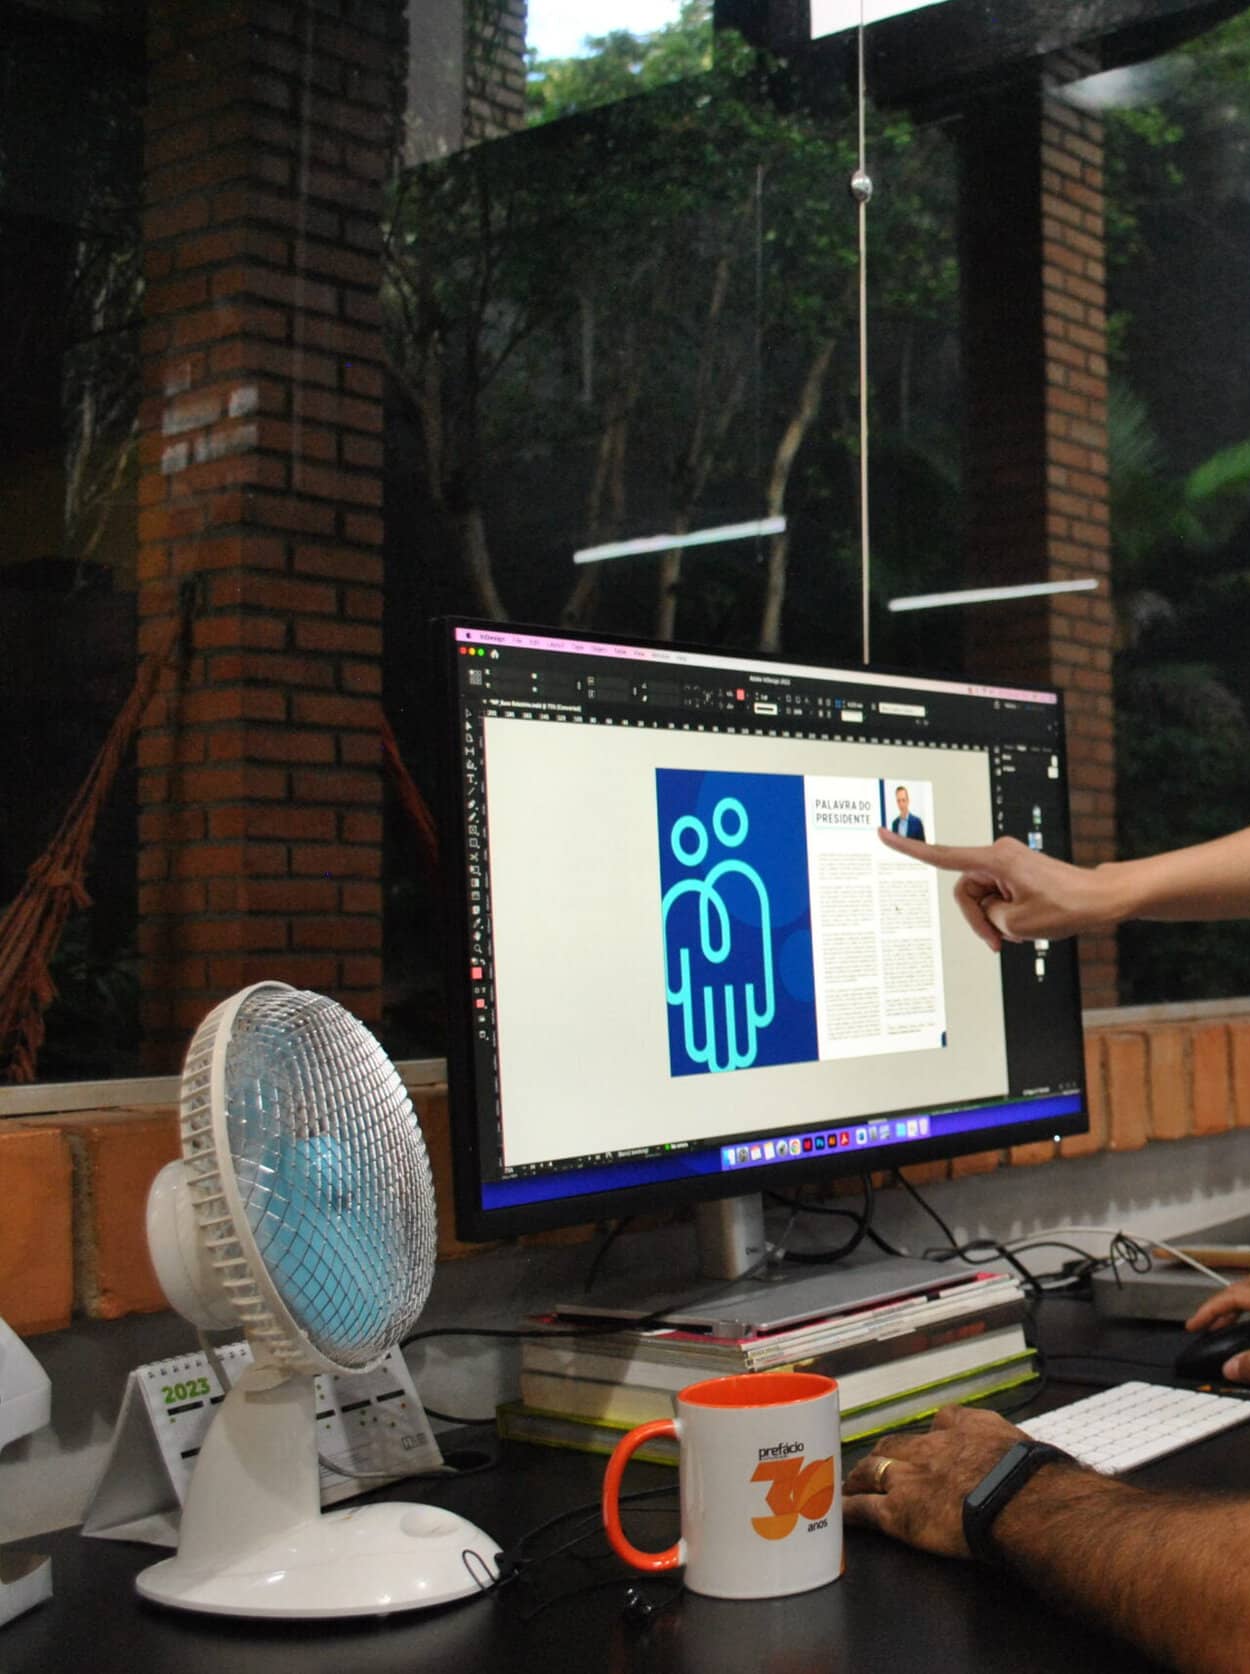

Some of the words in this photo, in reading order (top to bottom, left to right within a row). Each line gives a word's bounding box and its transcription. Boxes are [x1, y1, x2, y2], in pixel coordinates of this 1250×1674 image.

[815, 799, 857, 810] PALAVRA
[859, 800, 872, 811] DO
[816, 813, 871, 825] PRESIDENTE
[162, 1377, 211, 1404] 2023
[758, 1441, 805, 1461] prefácio
[808, 1519, 828, 1532] anos
